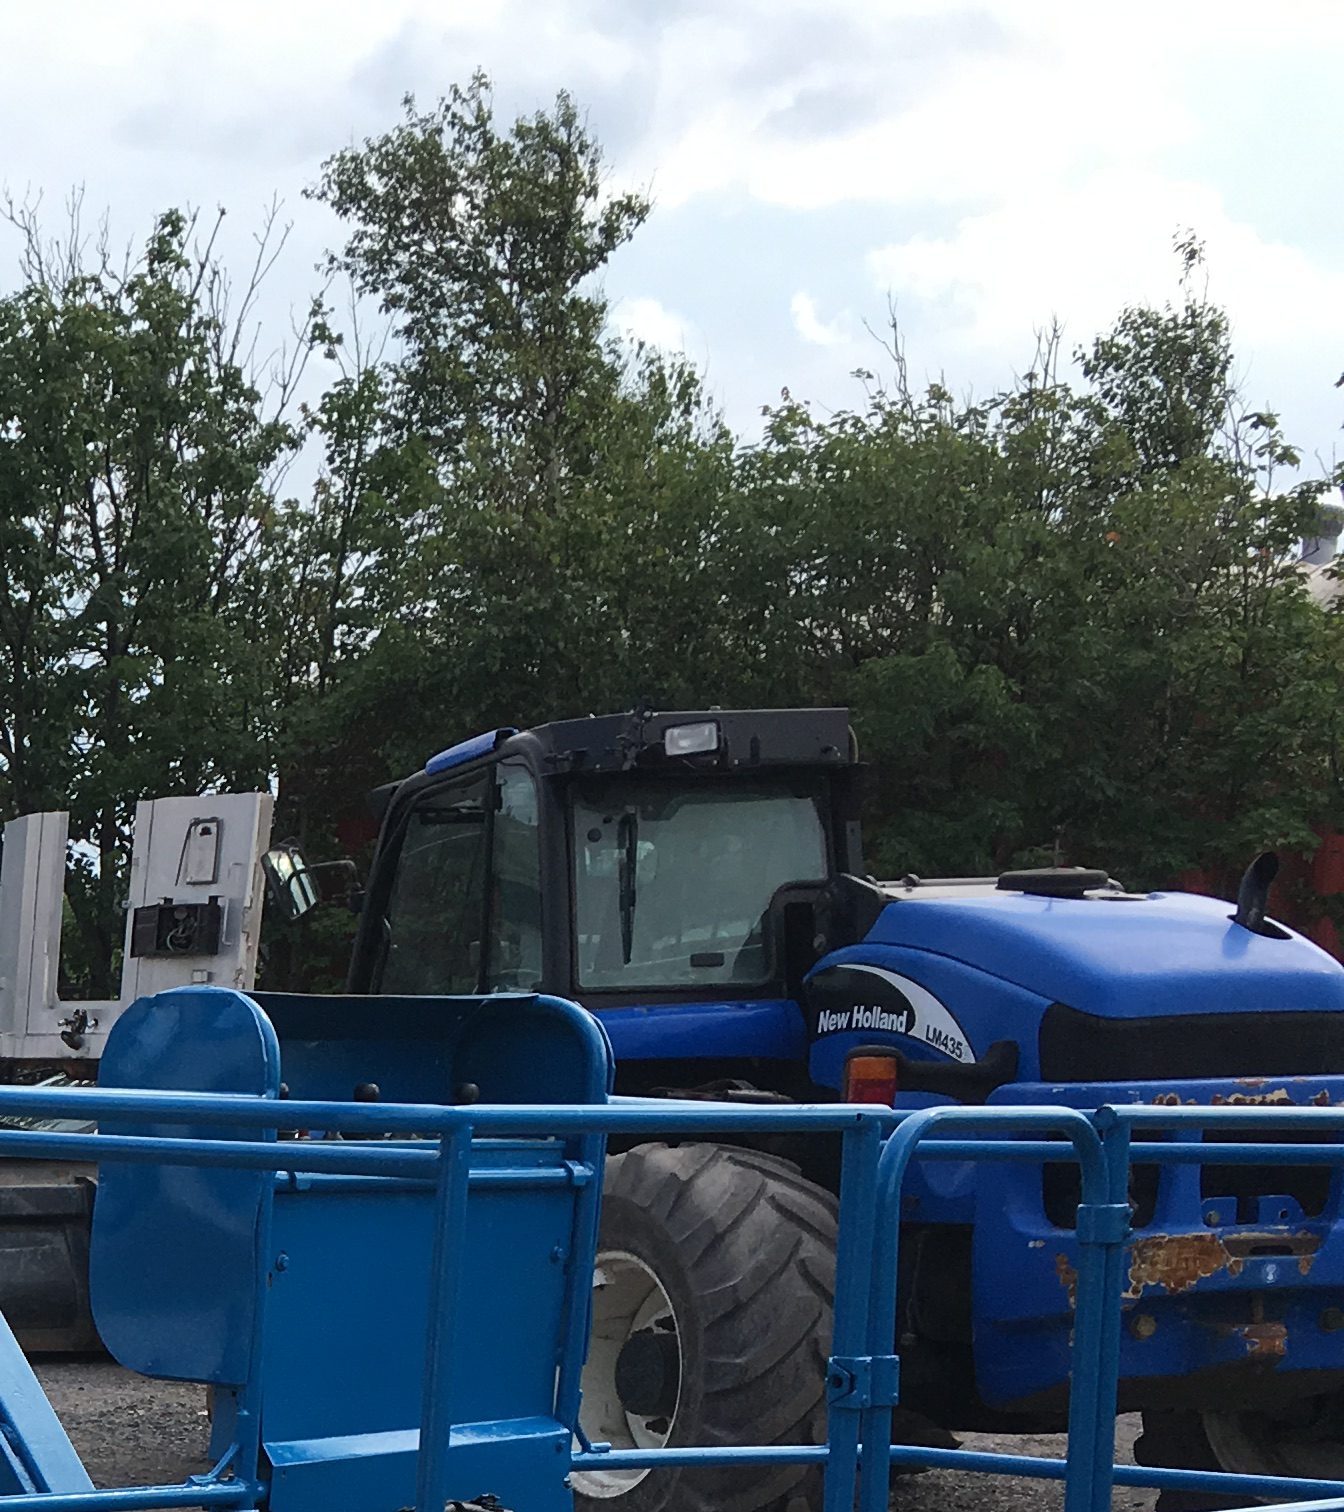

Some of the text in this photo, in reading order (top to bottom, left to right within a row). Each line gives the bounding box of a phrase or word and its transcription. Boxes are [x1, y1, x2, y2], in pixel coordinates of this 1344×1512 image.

[817, 1005, 909, 1034] New Holland
[925, 1024, 964, 1059] LM435
